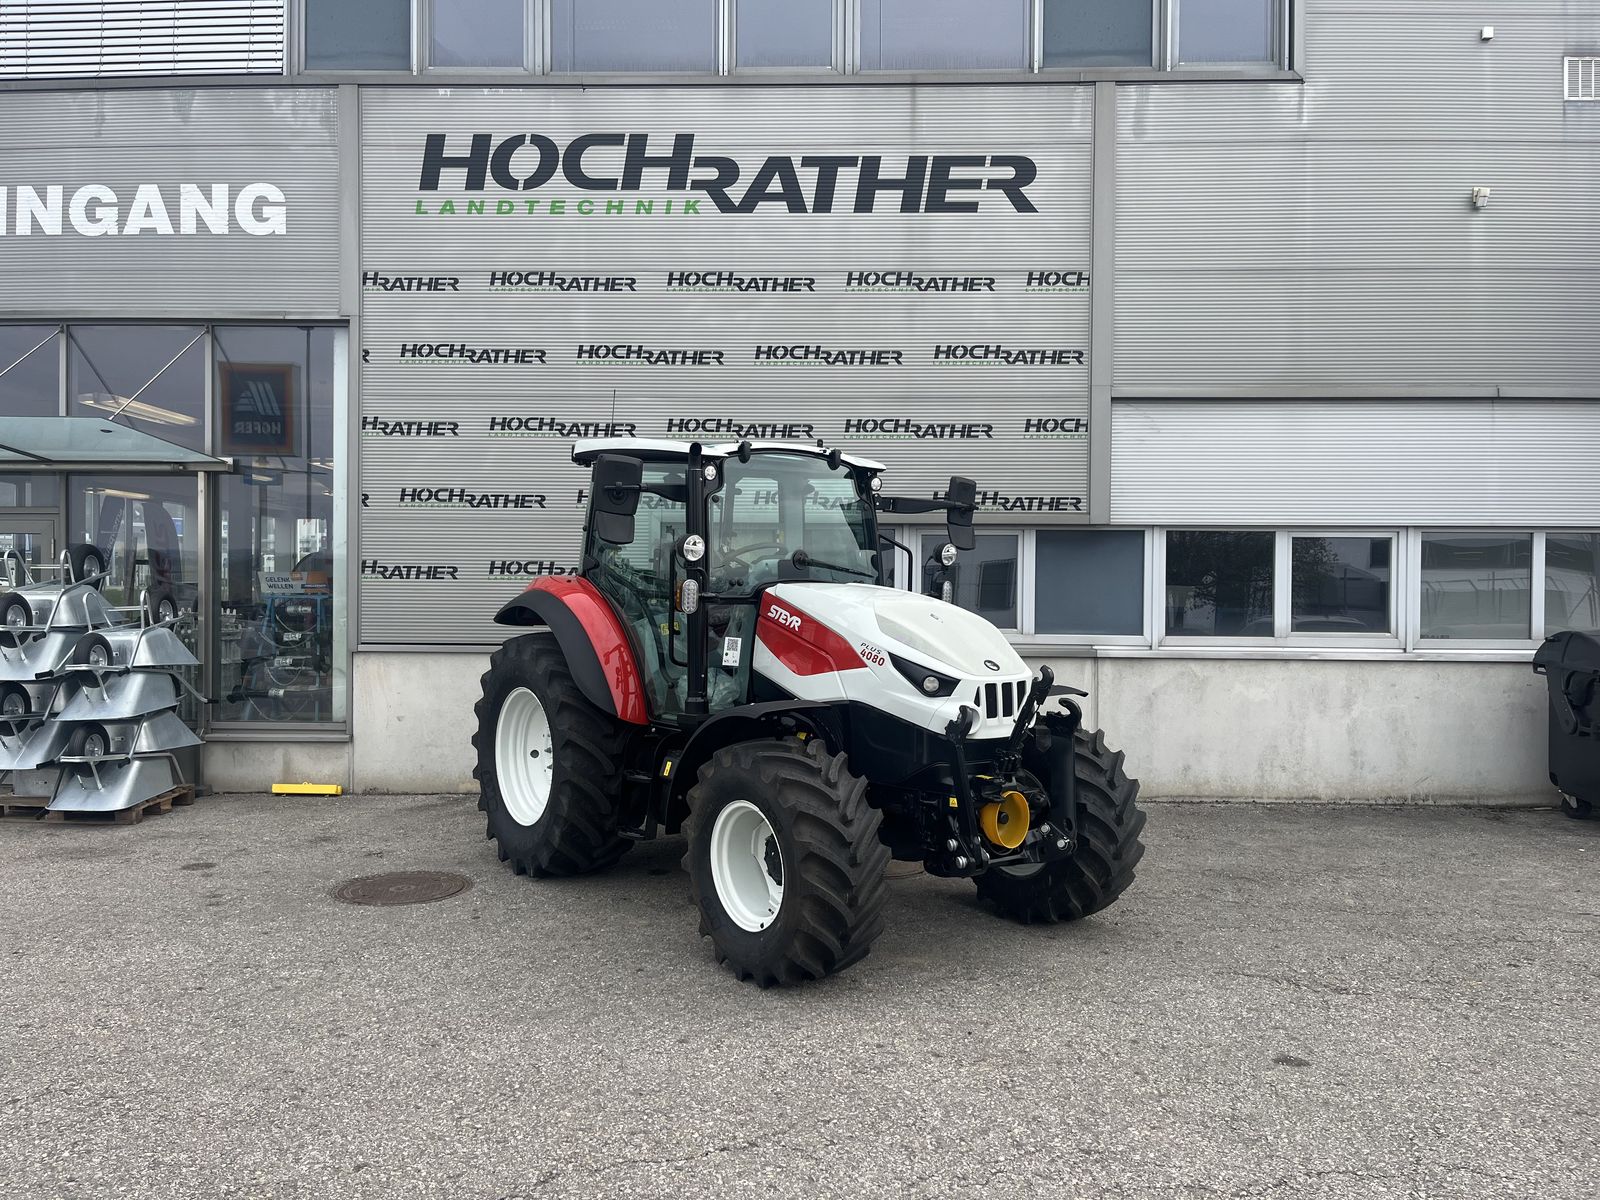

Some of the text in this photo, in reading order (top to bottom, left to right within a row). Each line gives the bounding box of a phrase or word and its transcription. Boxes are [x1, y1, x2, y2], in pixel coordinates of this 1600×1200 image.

[418, 133, 1039, 213] HOCHRATHER
[415, 200, 702, 215] LANDTECHNIK
[489, 271, 637, 291] HOCHRATHER
[667, 271, 815, 292] HOCHRATHER
[846, 271, 996, 292] HOCHRATHER
[400, 343, 547, 364] HOCHRATHER
[577, 345, 725, 365] HOCHRATHER
[755, 345, 903, 365] HOCHRATHER
[934, 345, 1084, 365] HOCHRATHER
[489, 417, 637, 437] HOCHRATHER
[667, 418, 814, 438] HOCHRATHER
[844, 419, 993, 438] HOCHRATHER
[399, 488, 546, 508] HOCHRATHER
[932, 491, 1082, 511] HHRATHER
[767, 604, 802, 632] STEYR
[860, 642, 882, 655] PLUS
[860, 648, 886, 667] 4080
